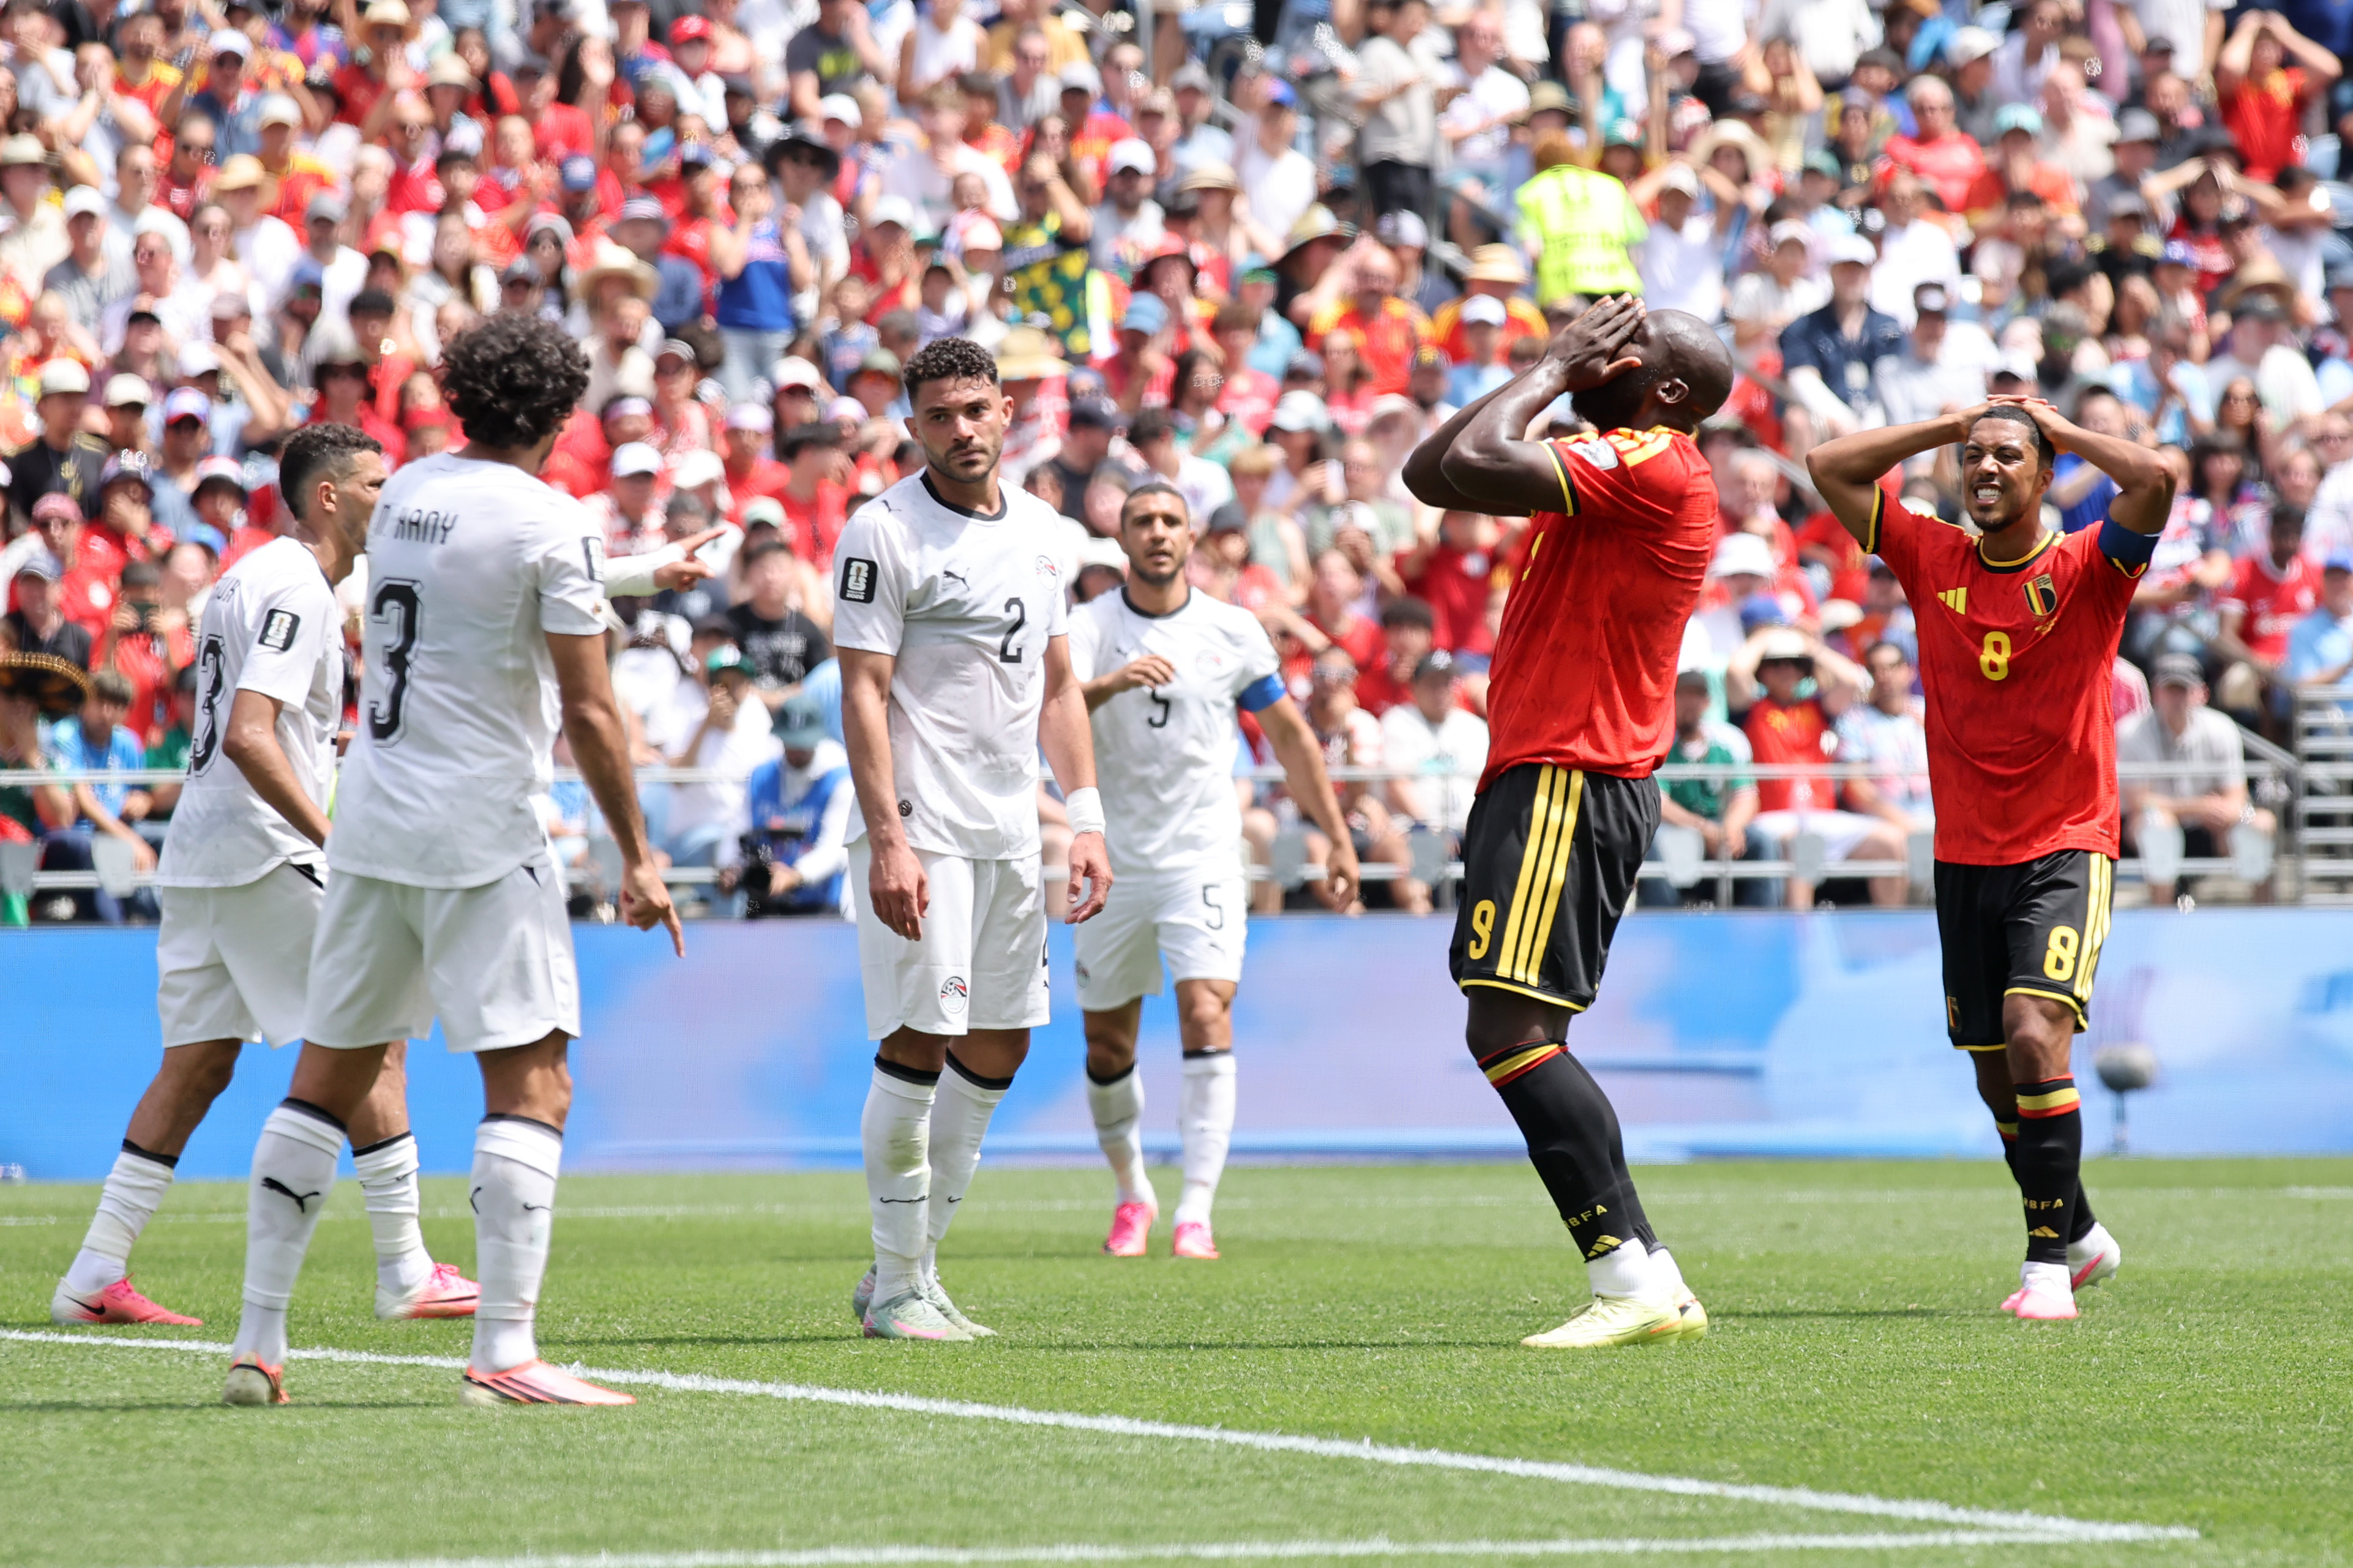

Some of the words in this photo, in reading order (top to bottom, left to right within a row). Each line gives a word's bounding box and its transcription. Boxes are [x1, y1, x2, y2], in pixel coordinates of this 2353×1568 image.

[1000, 597, 1025, 663] 2
[1979, 631, 2011, 681] 8
[370, 577, 425, 748] 3
[1148, 684, 1170, 728] 5
[1202, 884, 1222, 930] 5
[1469, 899, 1496, 960] 9
[2043, 925, 2079, 982] 8
